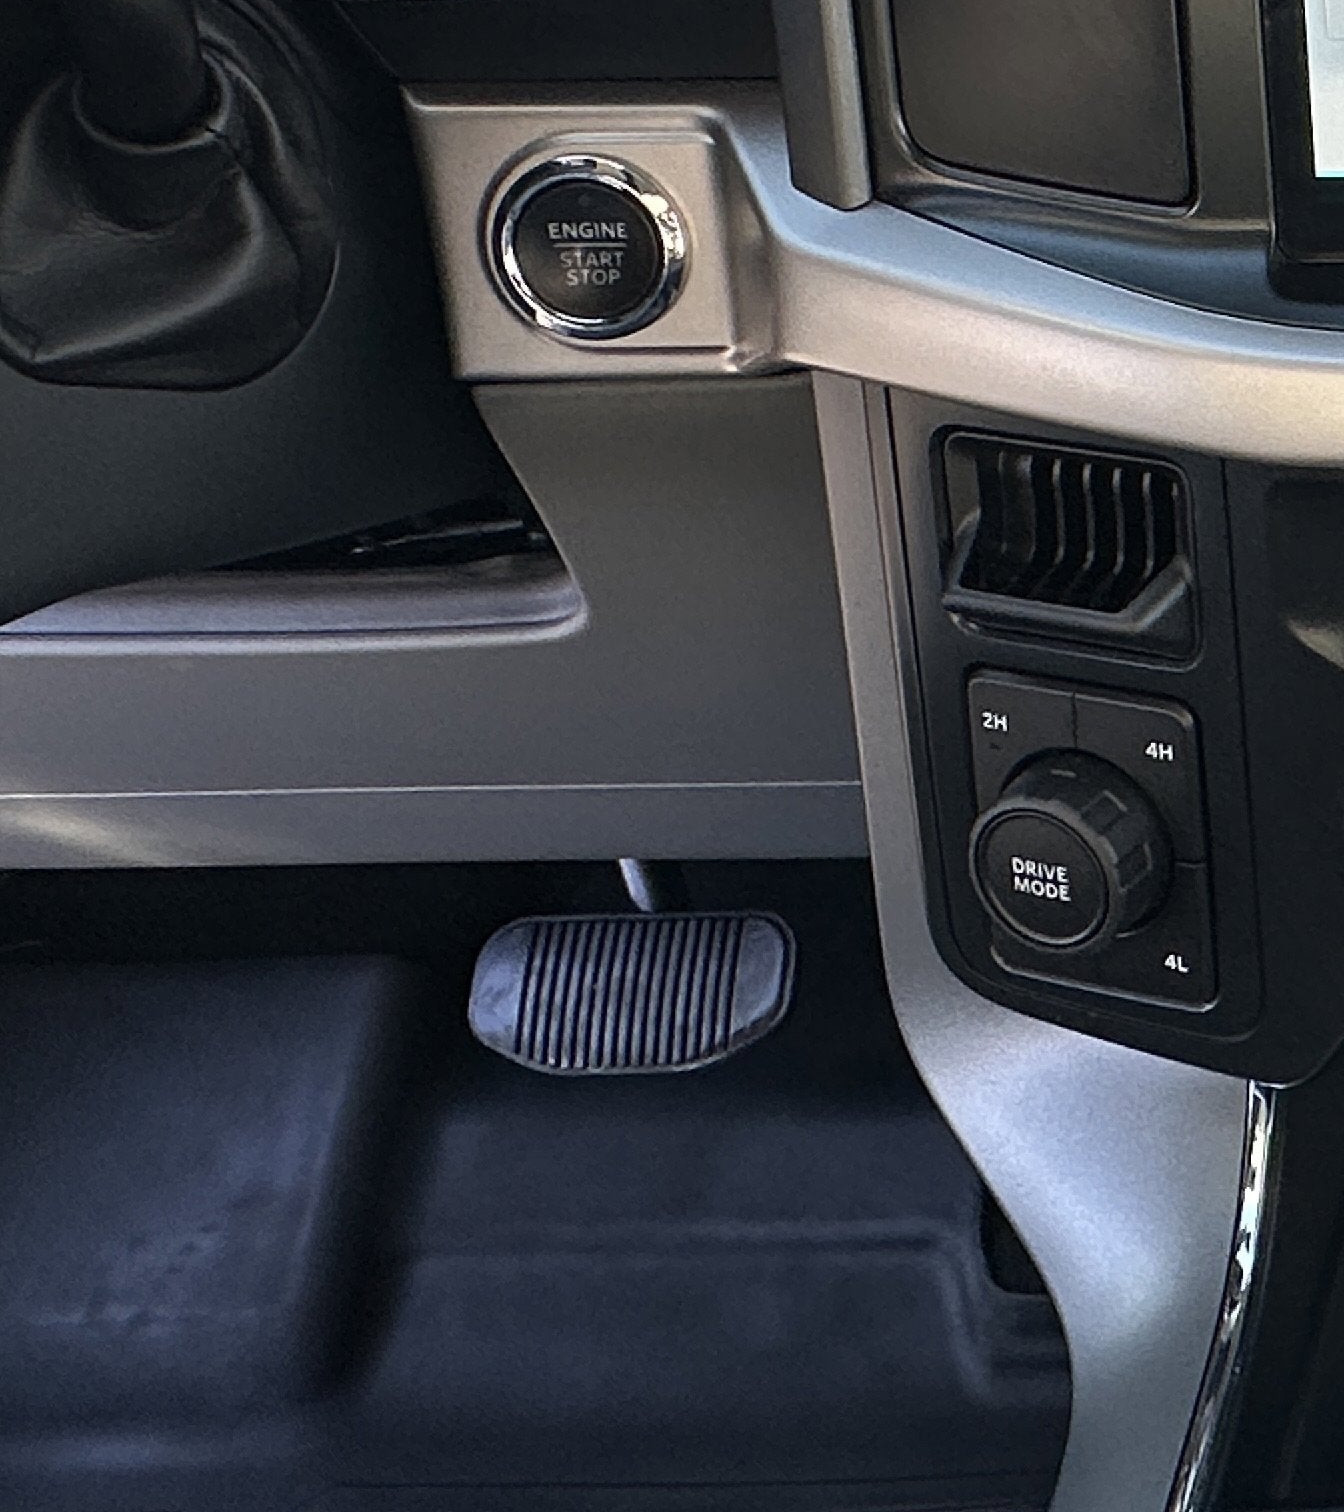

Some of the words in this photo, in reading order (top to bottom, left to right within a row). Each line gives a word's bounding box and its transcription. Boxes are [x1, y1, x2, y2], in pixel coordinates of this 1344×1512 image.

[548, 222, 628, 240] ENGINE
[560, 248, 623, 268] START
[565, 268, 620, 287] STOP
[982, 712, 1008, 732] 2H
[1145, 742, 1174, 761] 4H
[1011, 856, 1068, 885] DRIVE
[1014, 875, 1071, 902] MODE
[1164, 954, 1189, 973] 4L
